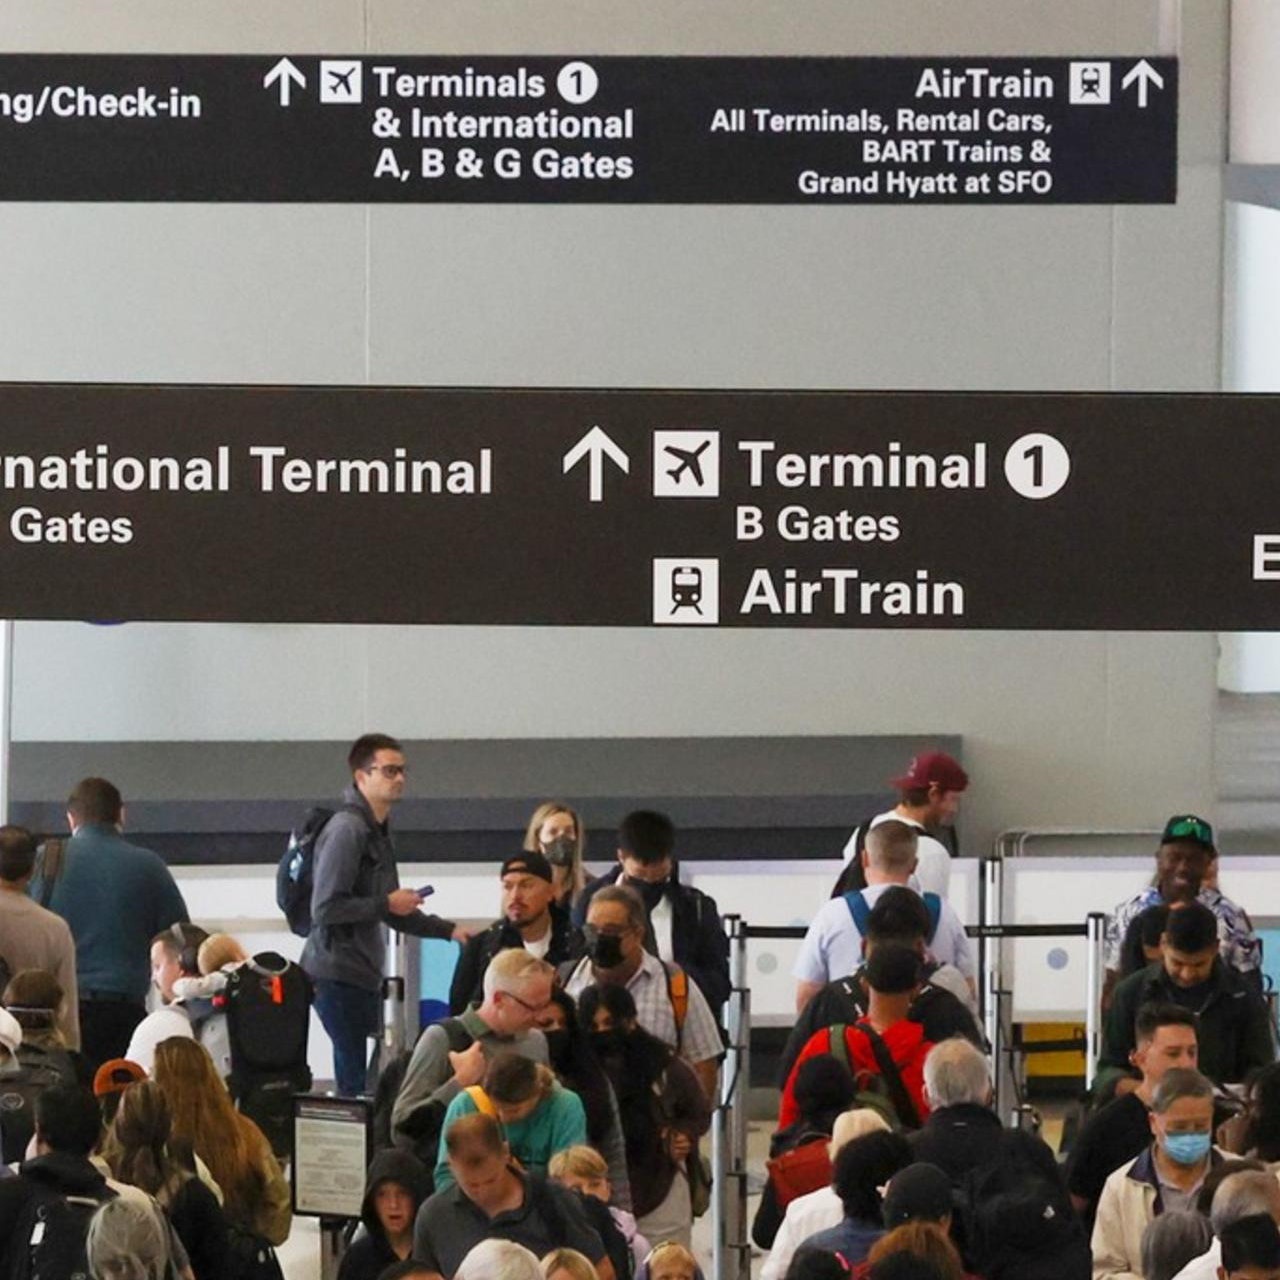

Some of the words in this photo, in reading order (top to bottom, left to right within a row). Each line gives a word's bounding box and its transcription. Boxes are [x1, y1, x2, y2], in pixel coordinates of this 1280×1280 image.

[372, 66, 547, 98] Terminals
[915, 68, 1053, 98] AirTrain
[372, 107, 401, 138] &
[412, 102, 633, 139] International
[710, 108, 745, 132] All
[752, 108, 889, 134] Terminals,
[897, 108, 980, 132] Rental
[987, 108, 1052, 134] Cars,
[373, 147, 410, 182] A,
[421, 148, 445, 178] B
[455, 147, 484, 179] &
[494, 148, 521, 179] G
[532, 148, 634, 179] Gates
[863, 139, 936, 163] BART
[942, 139, 1023, 163] Trains
[1029, 139, 1051, 163] &
[798, 170, 879, 194] Grand
[886, 170, 958, 199] Hyatt
[964, 173, 991, 194] at
[998, 170, 1052, 194] SFO
[249, 446, 493, 494] Terminal
[738, 441, 987, 489] Terminal
[10, 507, 133, 544] Gates
[736, 505, 764, 540] B
[777, 505, 900, 542] Gates
[740, 568, 964, 615] AirTrain
